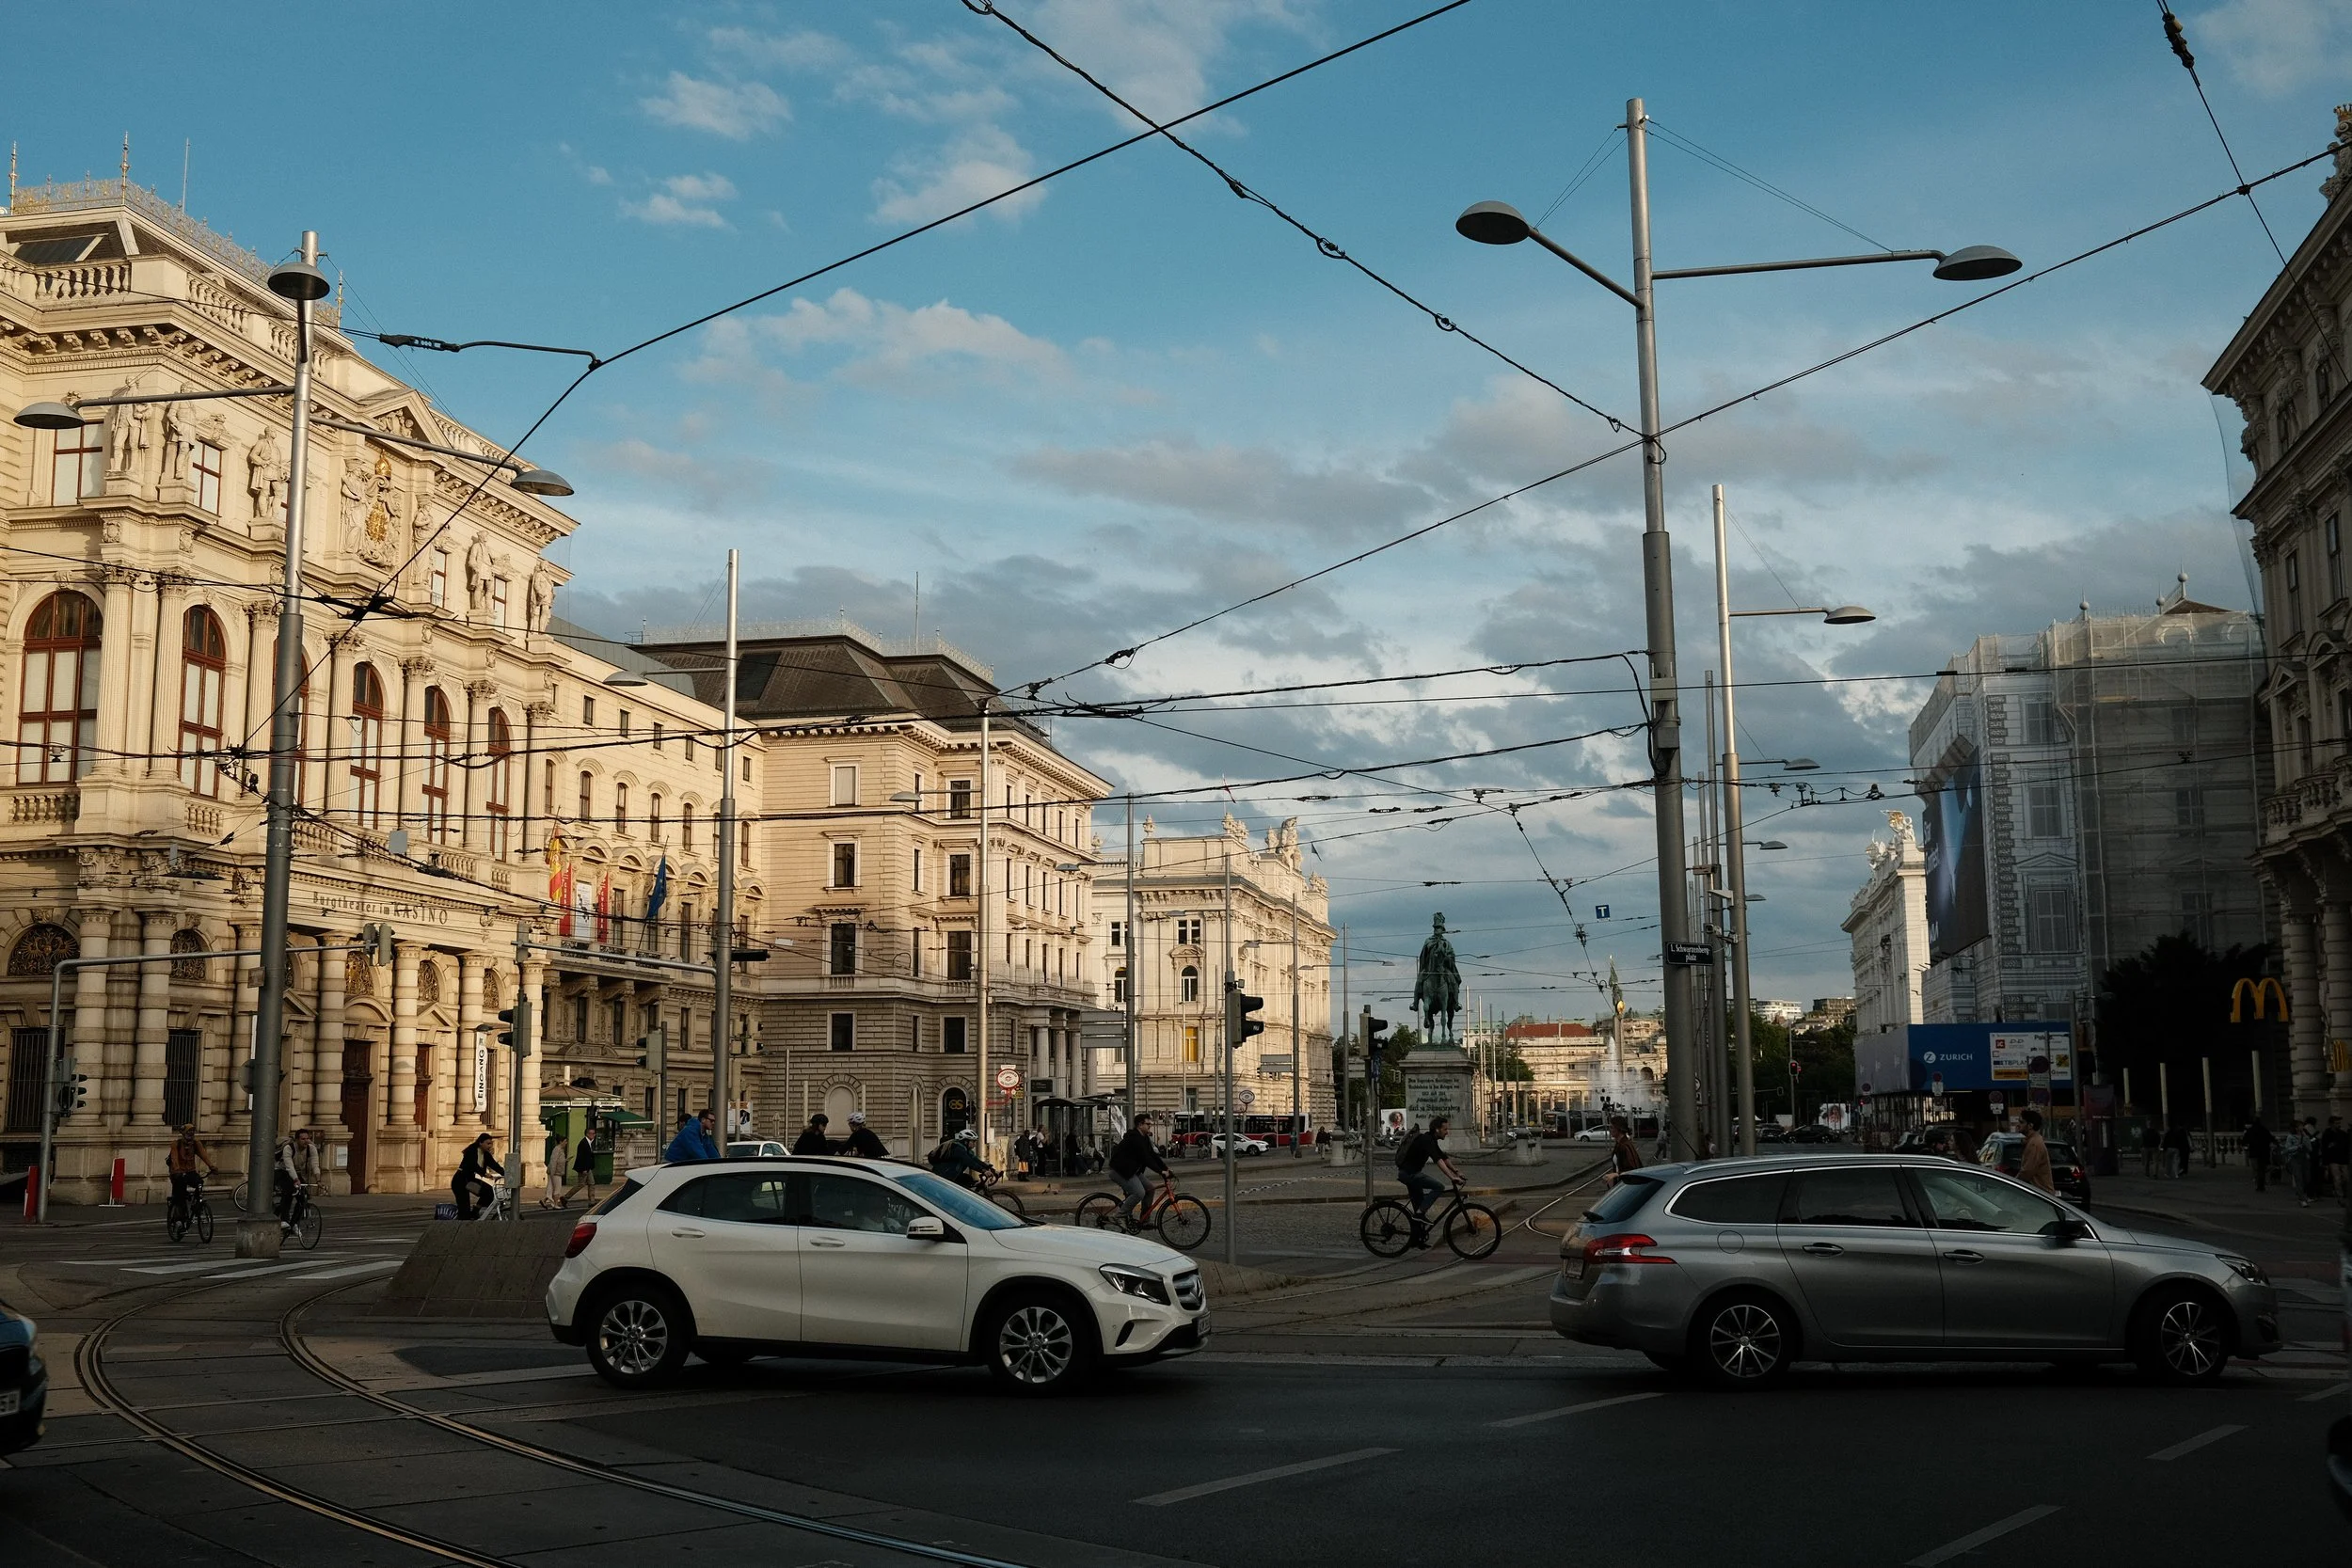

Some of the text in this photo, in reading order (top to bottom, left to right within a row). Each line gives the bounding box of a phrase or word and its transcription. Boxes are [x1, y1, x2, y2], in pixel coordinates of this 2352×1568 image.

[313, 892, 448, 925] Burgtheater im KASINO
[1685, 953, 1697, 963] platz
[1940, 1053, 1973, 1061] ZURICH
